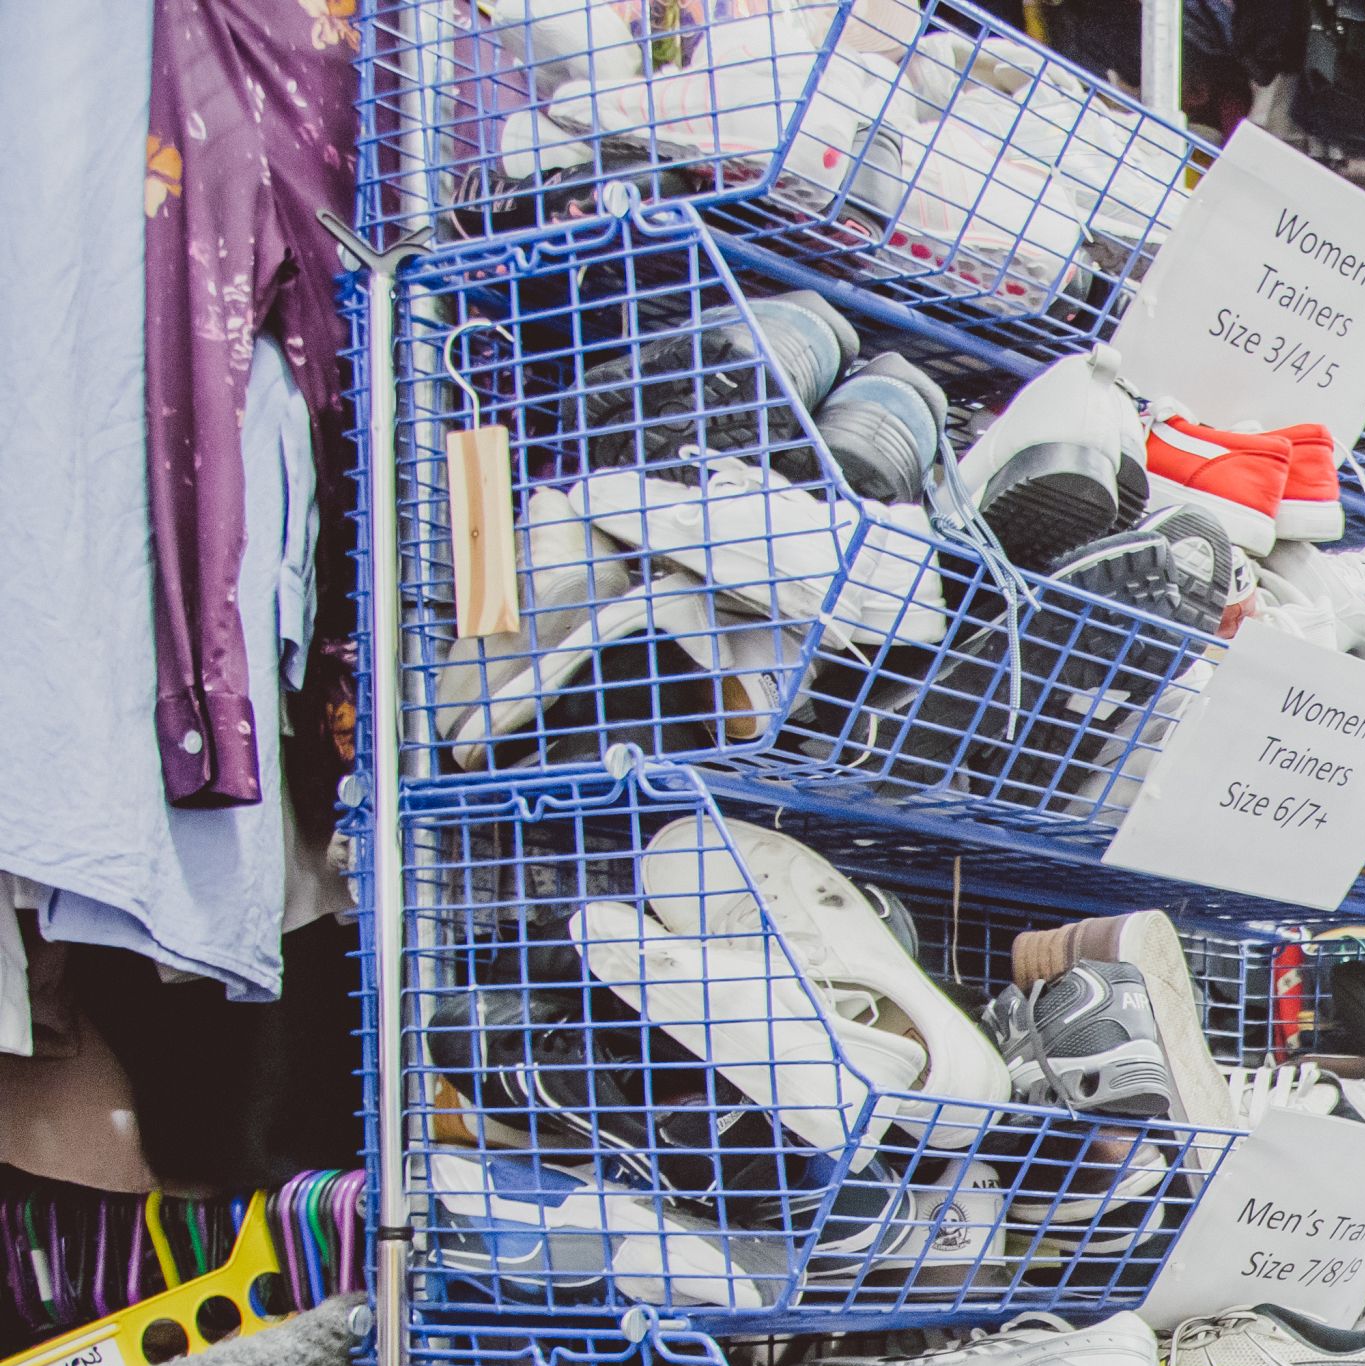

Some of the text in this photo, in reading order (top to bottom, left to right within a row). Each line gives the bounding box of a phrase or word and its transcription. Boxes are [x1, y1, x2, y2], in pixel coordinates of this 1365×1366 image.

[1255, 263, 1353, 337] Trainers
[1208, 308, 1262, 355] Size
[1257, 735, 1353, 787] Trainers
[1219, 780, 1328, 830] Size 6/7+
[1122, 991, 1150, 1011] AIR
[1236, 1198, 1325, 1237] Men's
[1241, 1251, 1363, 1287] Size 7/8/9
